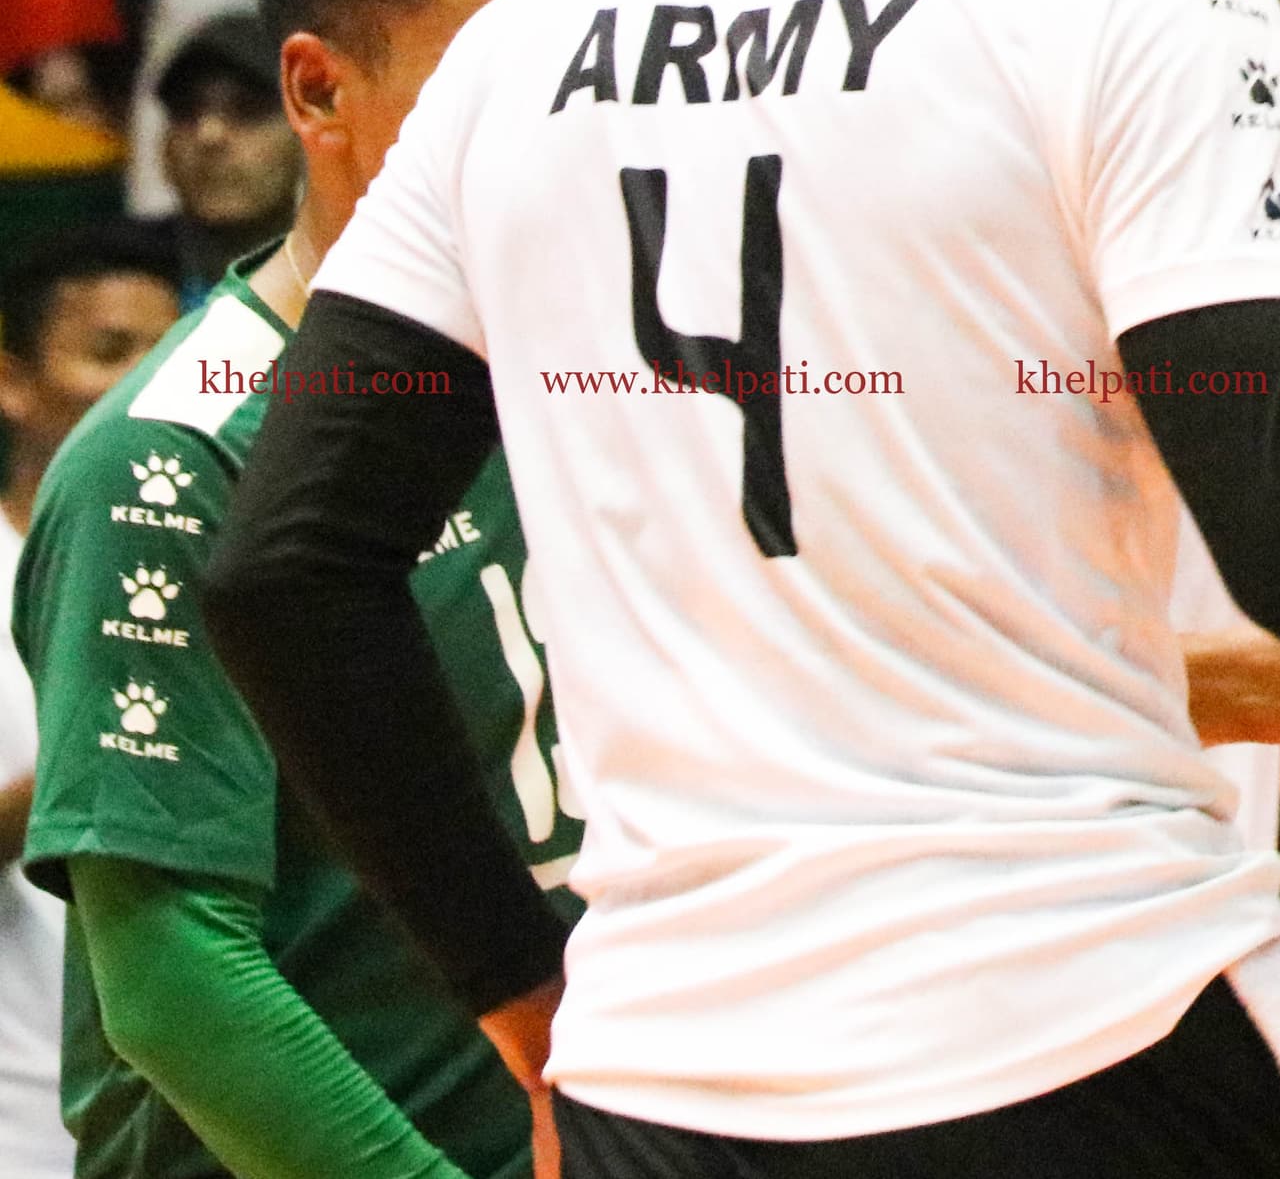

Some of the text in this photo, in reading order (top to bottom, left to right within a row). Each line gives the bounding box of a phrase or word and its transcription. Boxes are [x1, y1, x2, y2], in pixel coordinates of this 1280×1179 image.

[619, 153, 798, 557] 4
[110, 504, 204, 535] KELME
[102, 619, 191, 648] KELME
[99, 731, 181, 762] KELME
